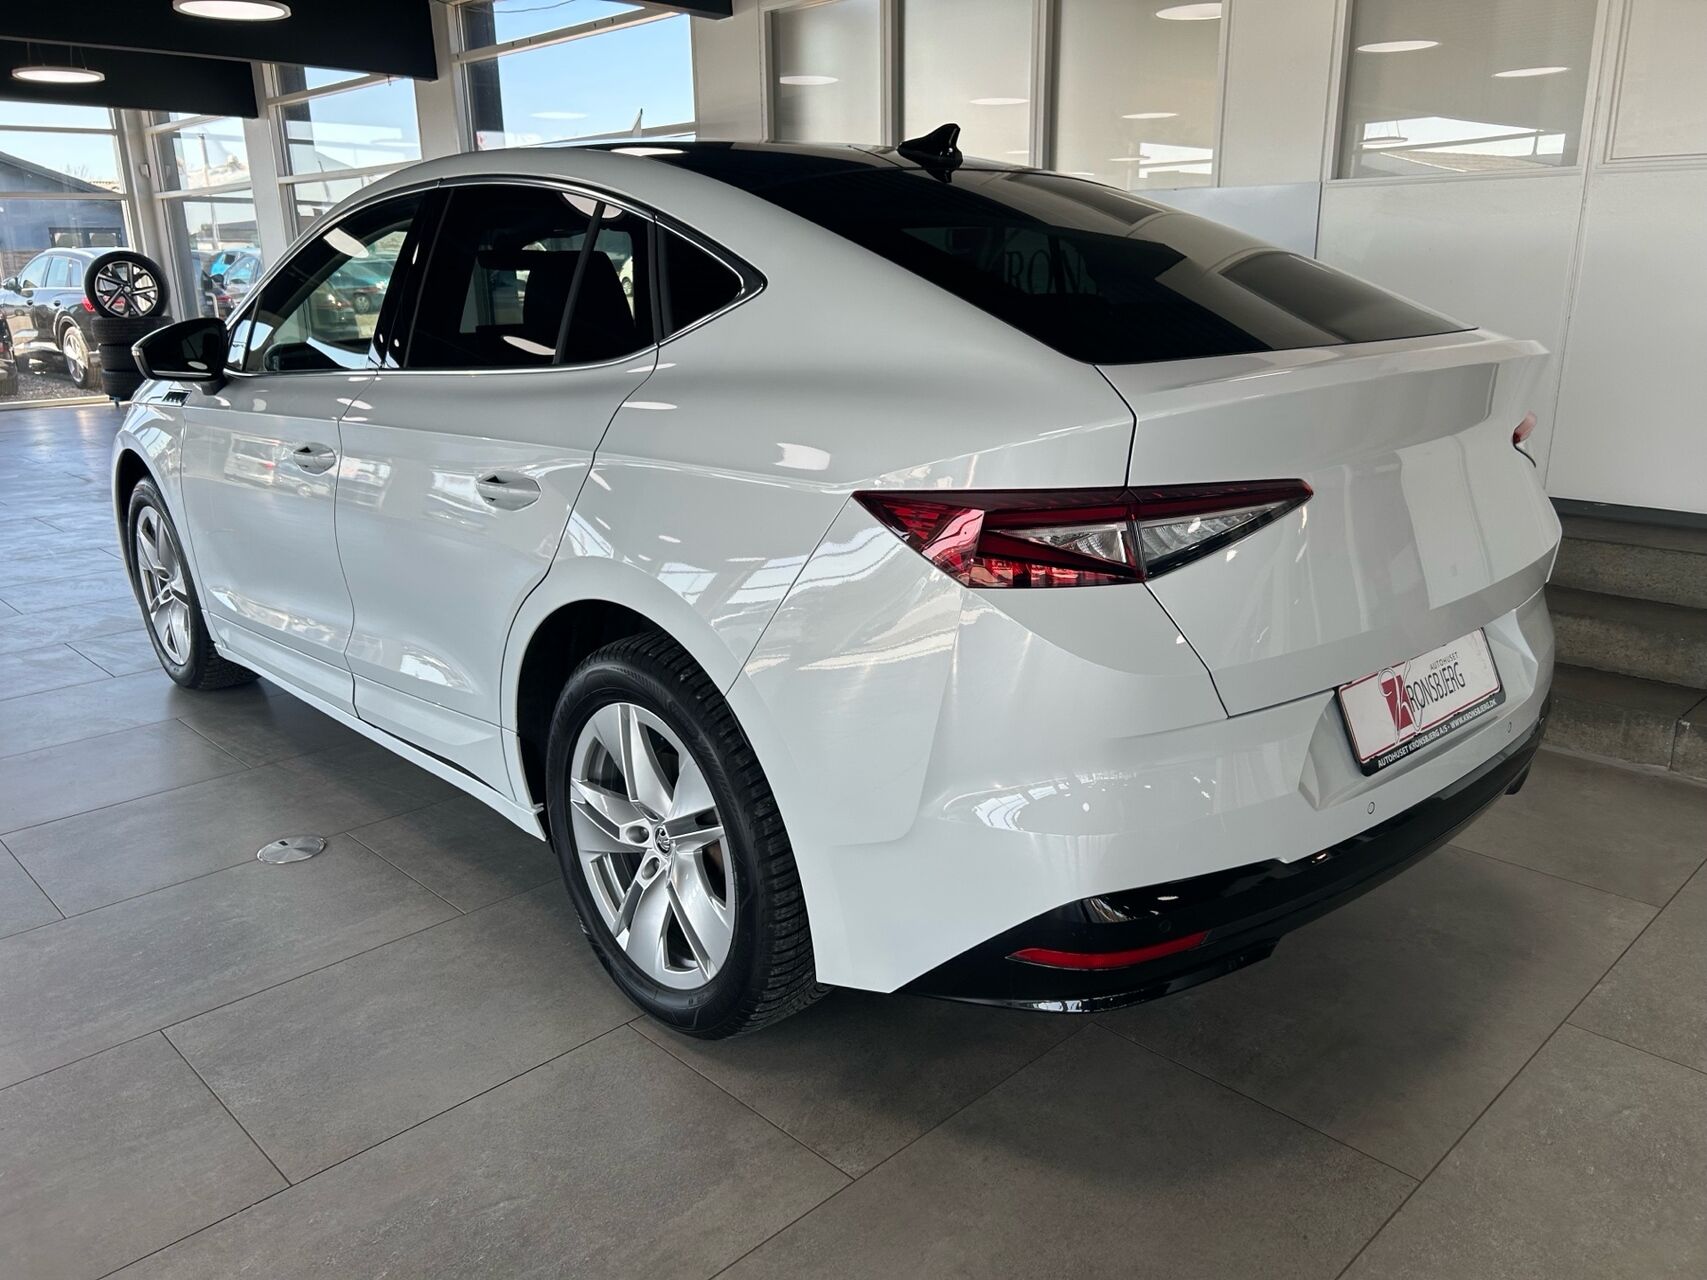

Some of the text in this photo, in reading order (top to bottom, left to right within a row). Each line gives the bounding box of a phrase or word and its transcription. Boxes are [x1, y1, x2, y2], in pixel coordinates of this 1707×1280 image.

[1430, 651, 1459, 670] AUTOHUSET
[1377, 746, 1409, 769] AUTOHUSET
[1408, 729, 1440, 753] KRONSBJERG
